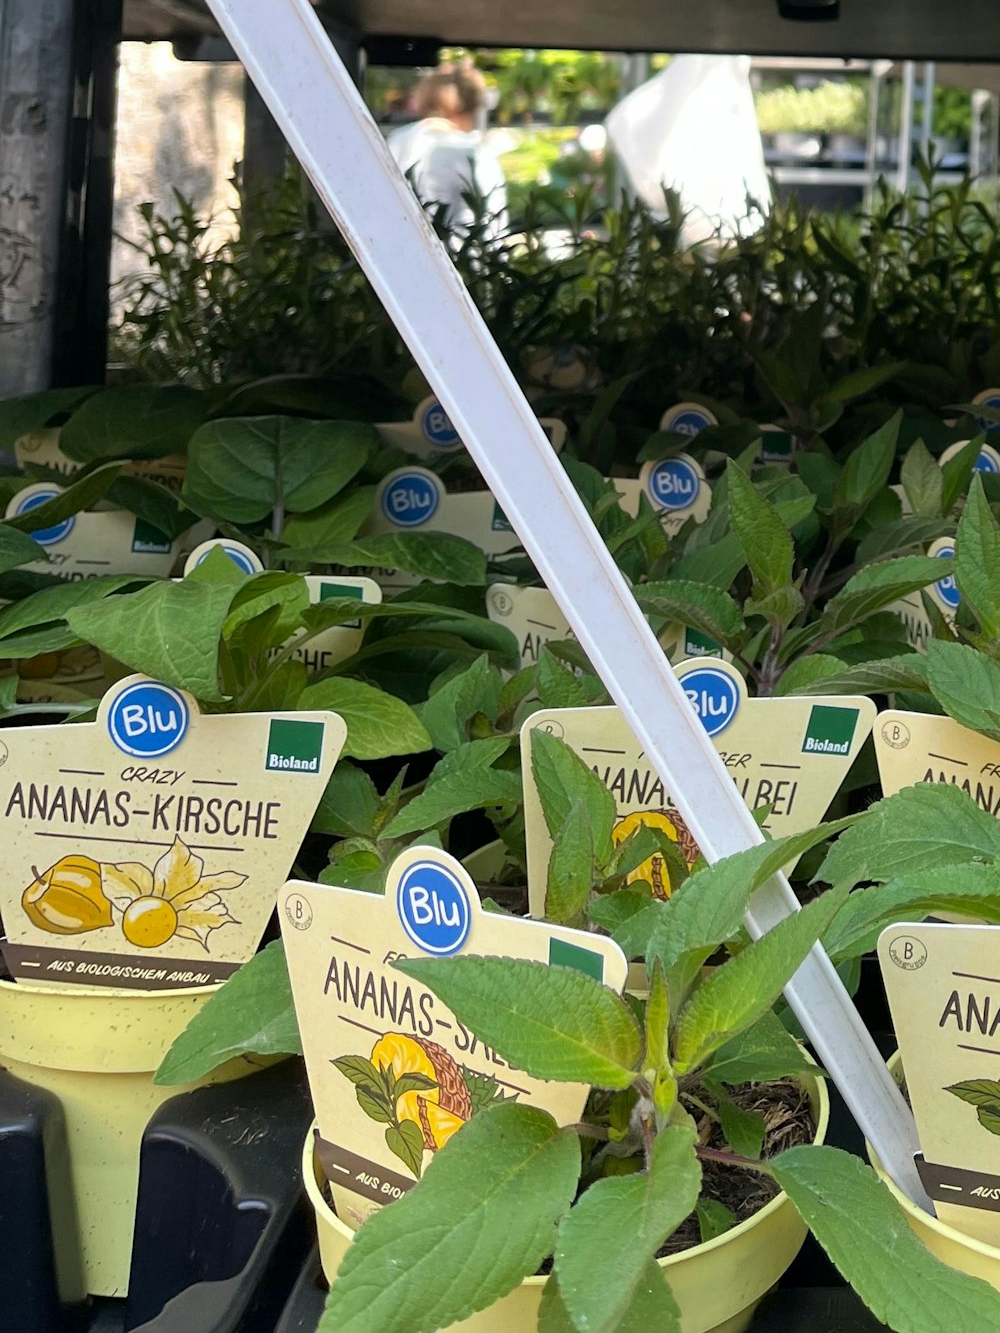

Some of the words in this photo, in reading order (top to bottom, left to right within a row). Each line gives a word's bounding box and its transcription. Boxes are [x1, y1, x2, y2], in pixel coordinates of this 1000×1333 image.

[656, 471, 692, 495] Blu
[390, 488, 430, 513] Blu
[121, 703, 178, 737] Blu
[892, 725, 900, 741] B
[805, 736, 850, 753] Bioland
[269, 754, 318, 771] Bioland
[120, 766, 186, 786] CRAZY
[5, 781, 281, 839] ANANAS-KIRSCHE
[295, 900, 303, 919] B
[409, 886, 461, 927] Blu
[904, 942, 914, 960] B
[47, 960, 75, 973] AUS
[75, 962, 165, 981] BIOLOGISCHEM
[166, 971, 210, 984] ANBAU
[355, 1172, 380, 1190] AUS
